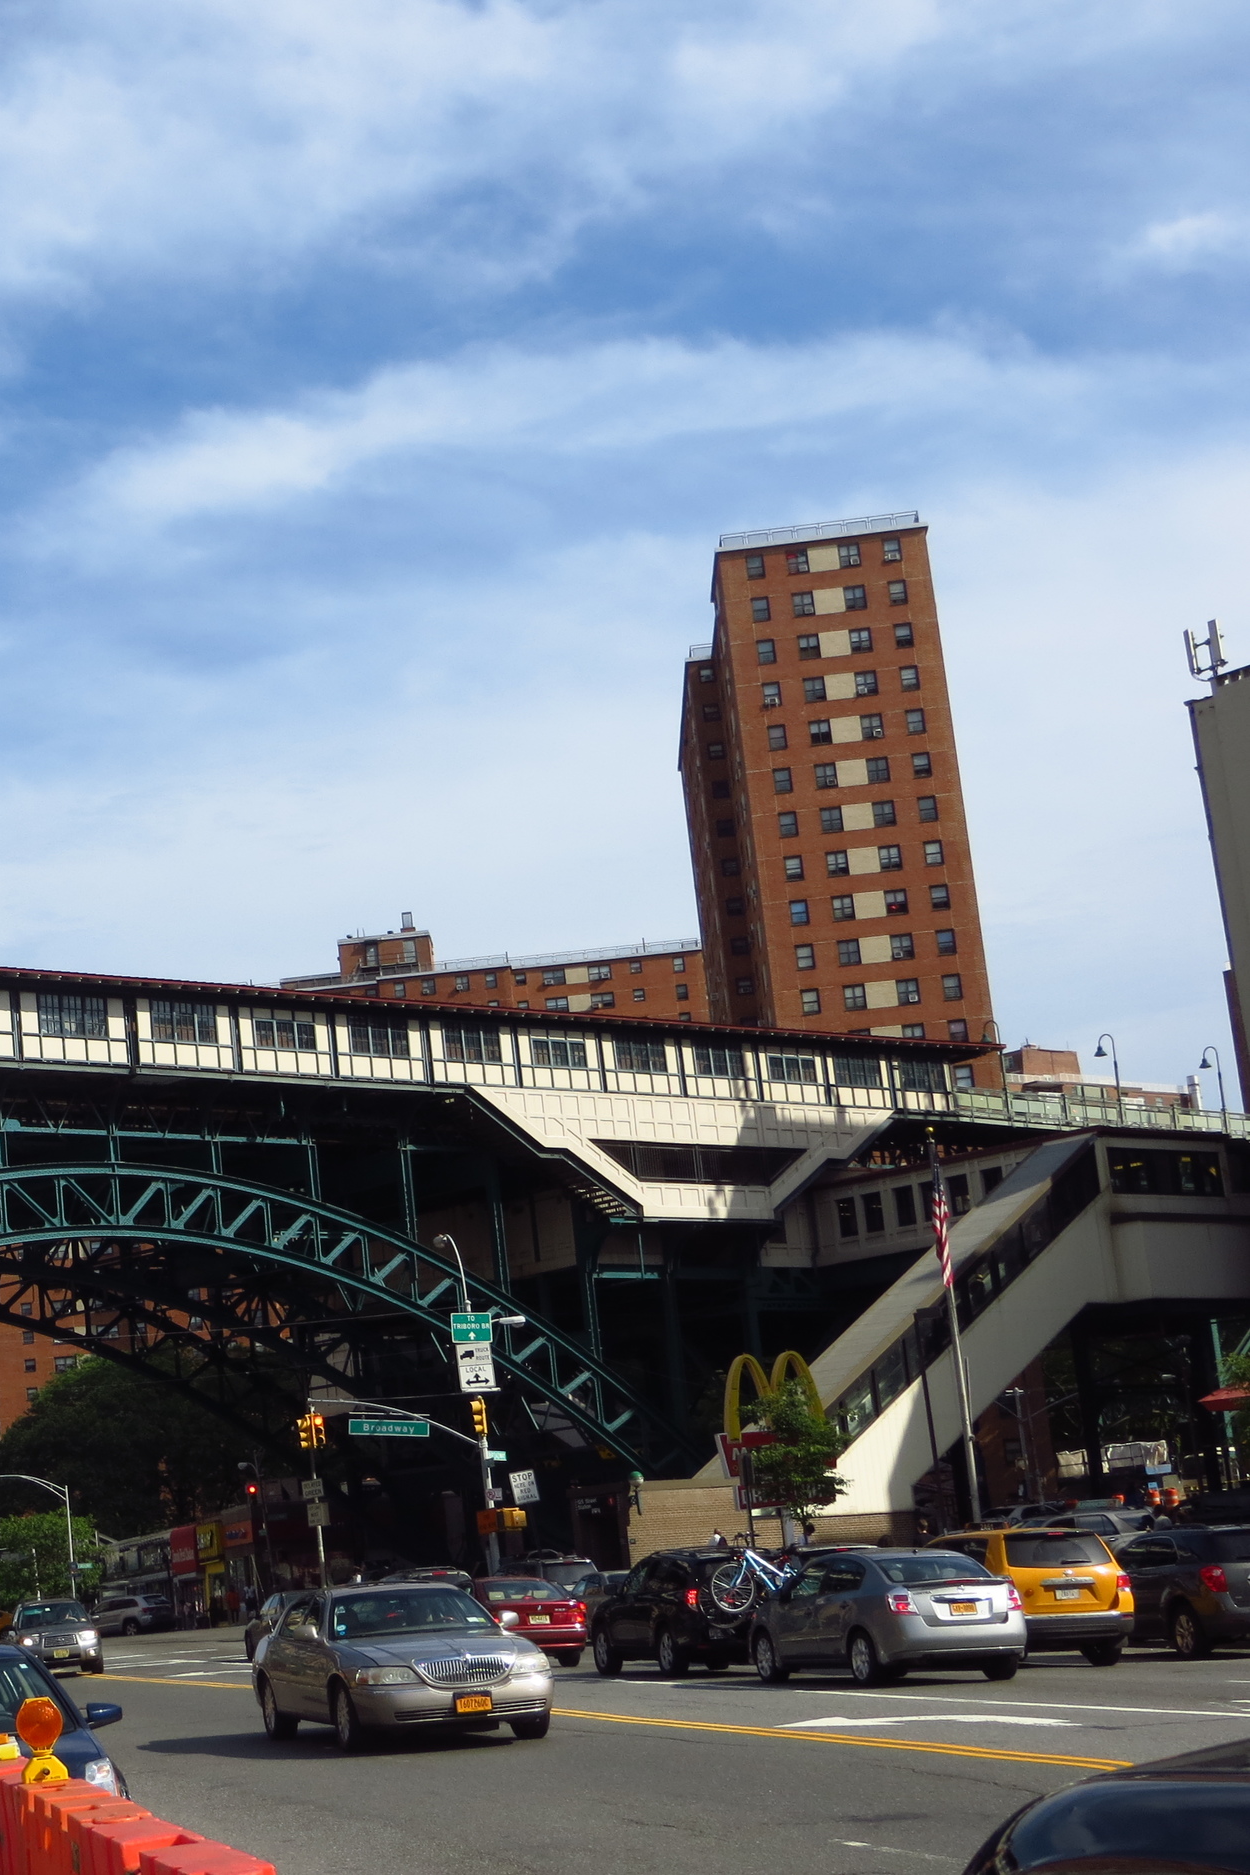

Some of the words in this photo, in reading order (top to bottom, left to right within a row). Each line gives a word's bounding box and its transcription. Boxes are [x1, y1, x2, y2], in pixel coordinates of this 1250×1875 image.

[363, 1423, 415, 1434] Broadway
[512, 1472, 533, 1483] STOP
[517, 1493, 537, 1501] SIGNAL
